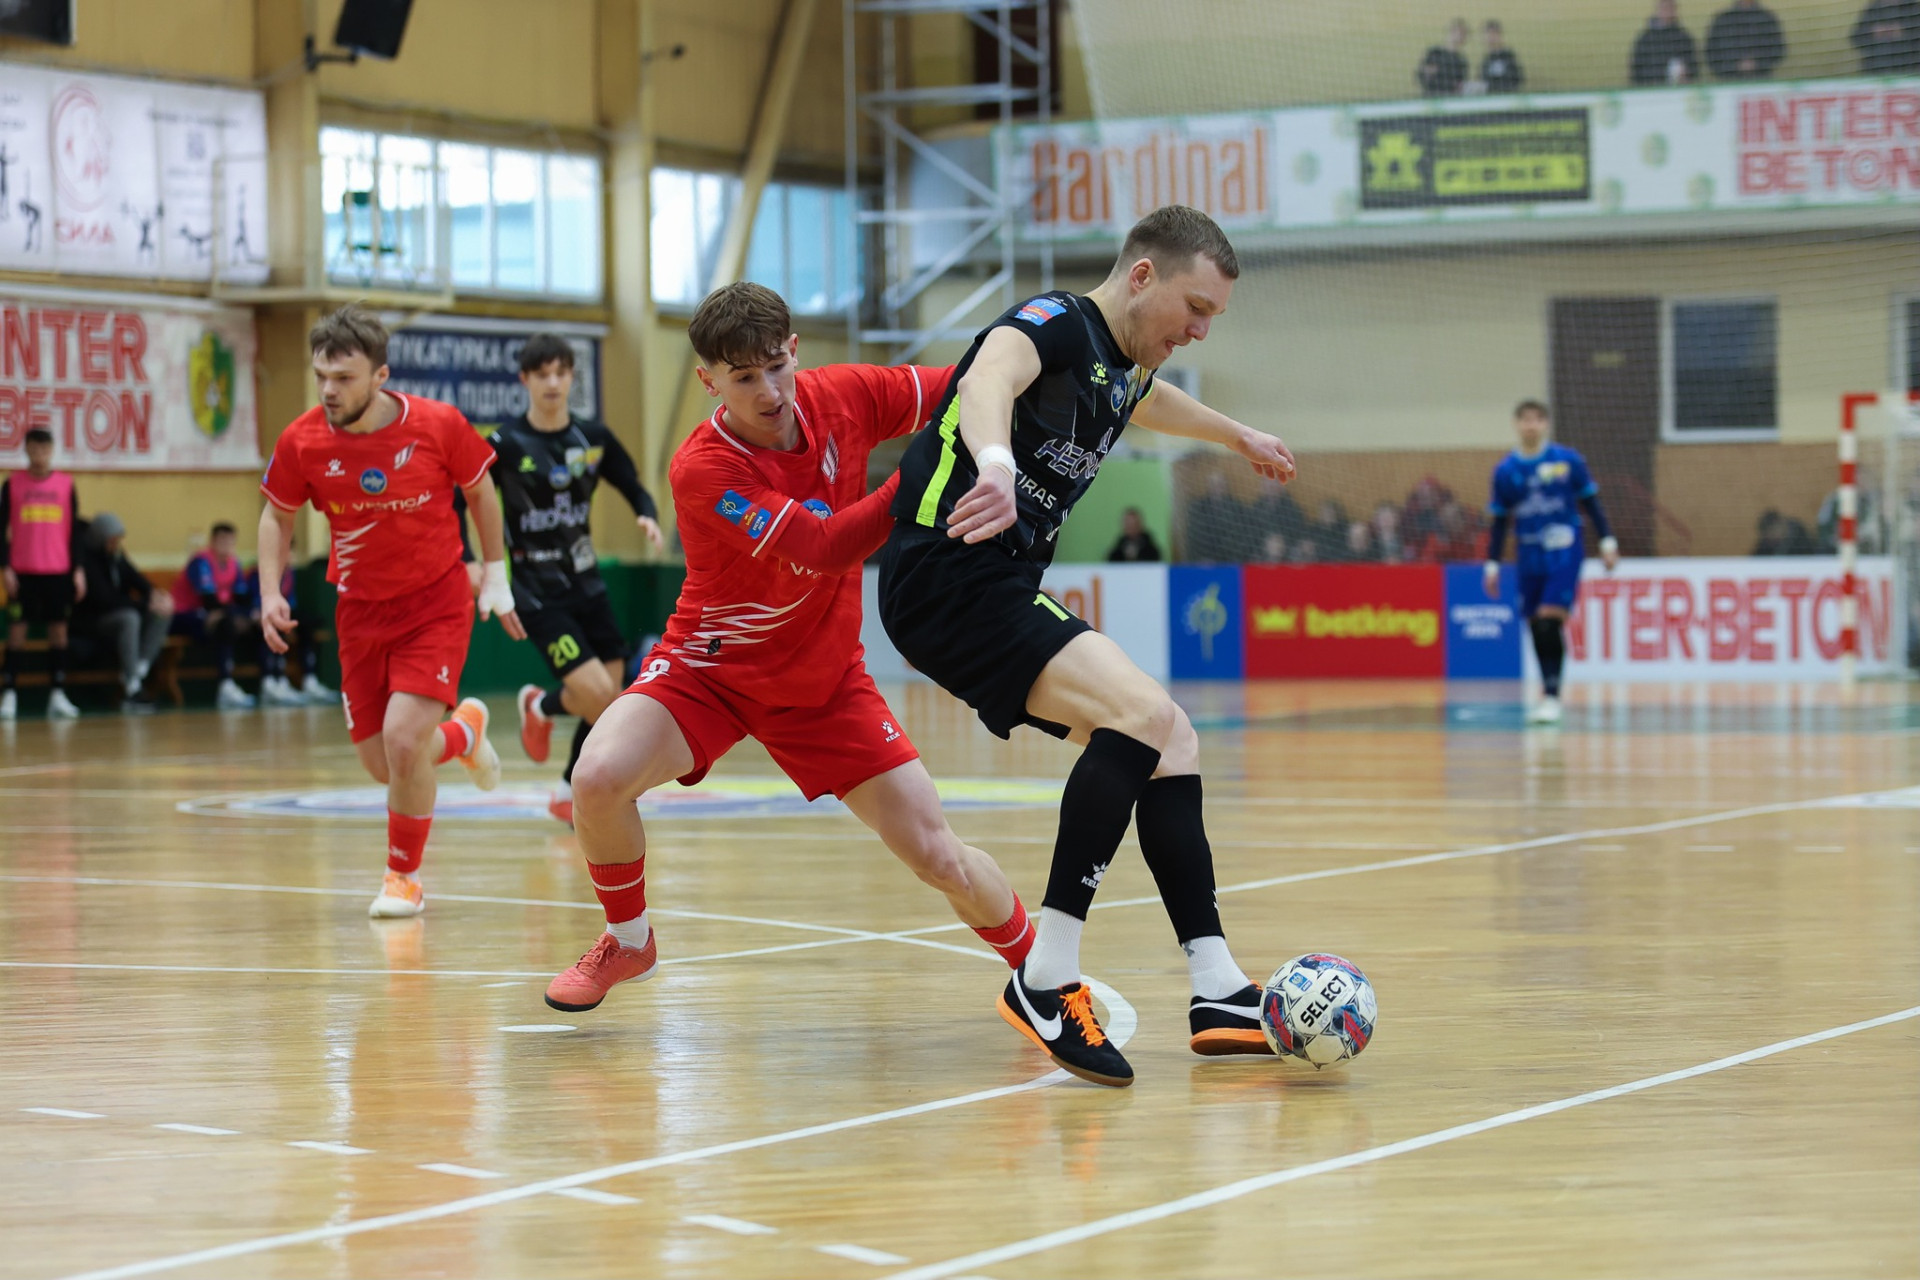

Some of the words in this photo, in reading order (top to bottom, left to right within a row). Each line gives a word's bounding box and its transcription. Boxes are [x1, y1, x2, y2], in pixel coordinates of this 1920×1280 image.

[1738, 92, 1920, 143] INTER
[1738, 146, 1920, 195] BETON
[1, 307, 149, 384] NTER
[1565, 576, 1894, 663] NTER-BETON
[547, 634, 580, 669] 20
[1300, 975, 1347, 1028] SELECT
